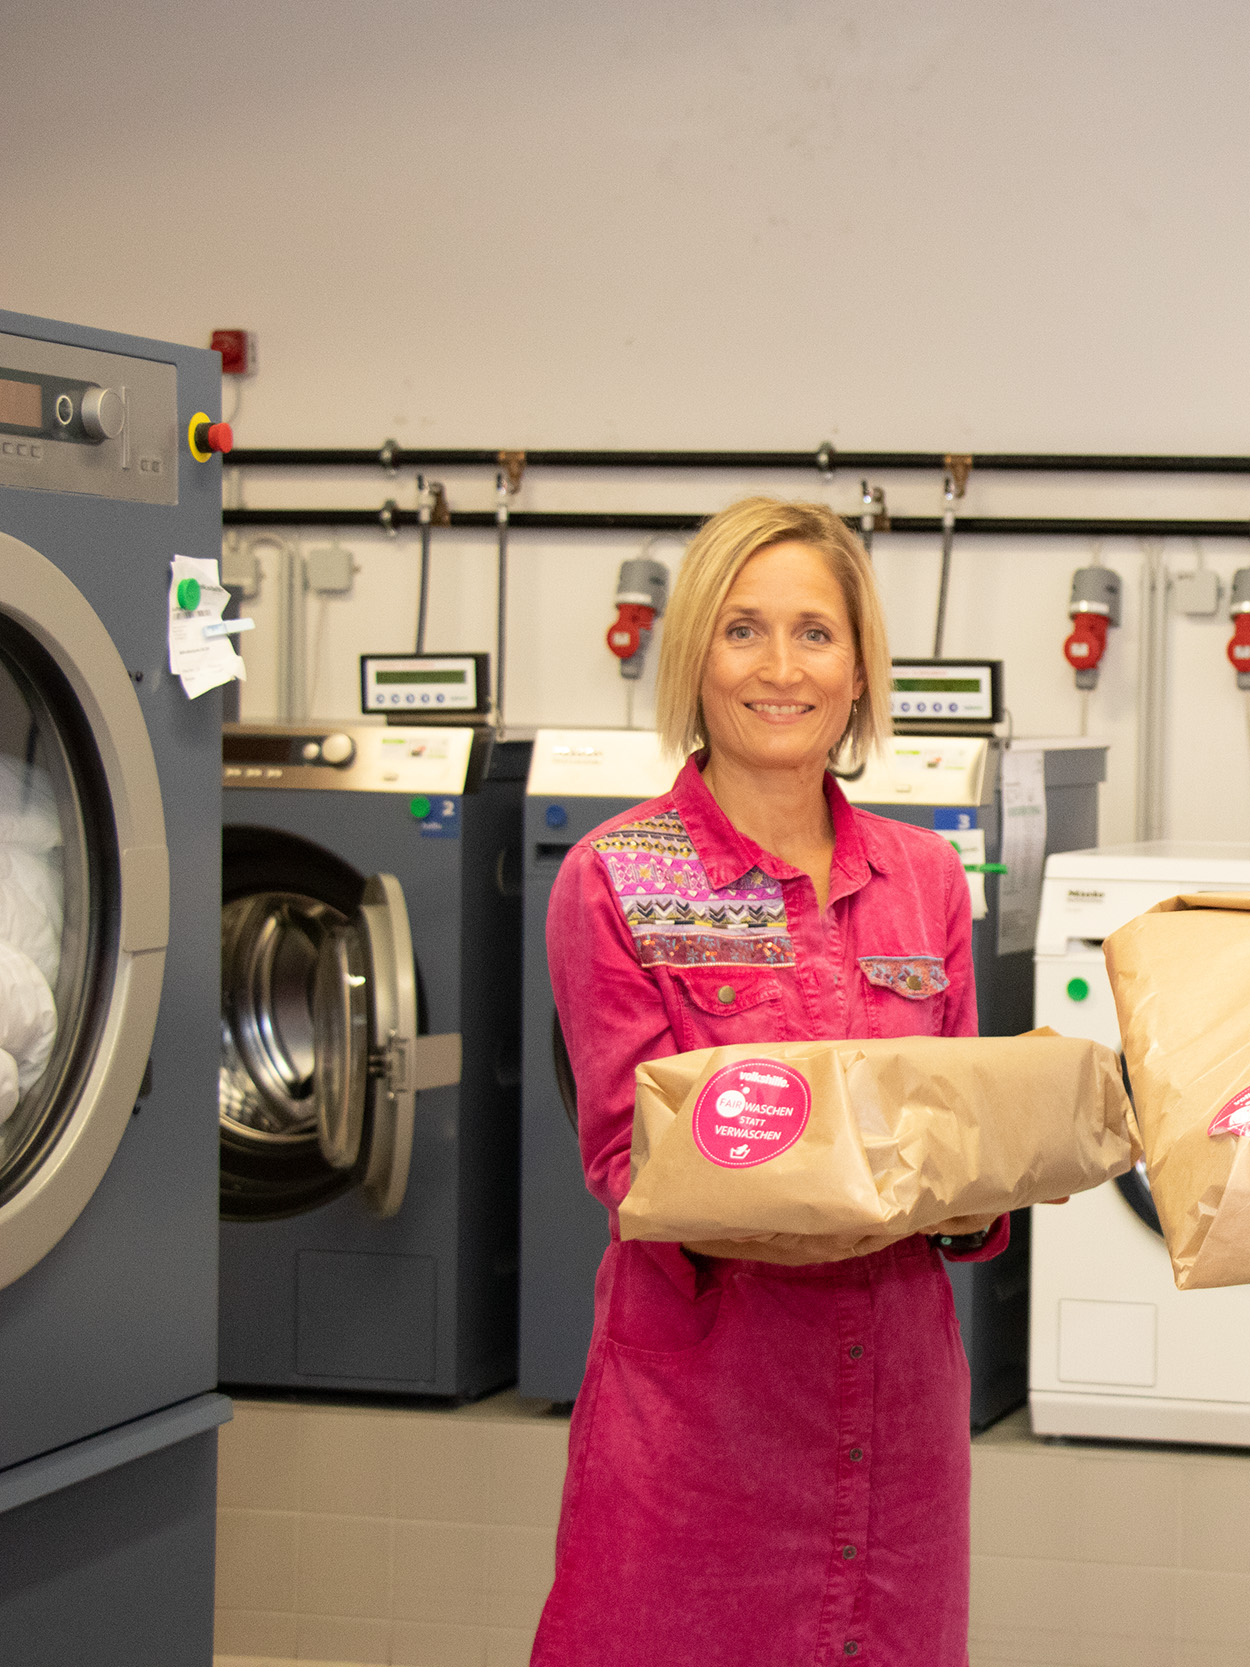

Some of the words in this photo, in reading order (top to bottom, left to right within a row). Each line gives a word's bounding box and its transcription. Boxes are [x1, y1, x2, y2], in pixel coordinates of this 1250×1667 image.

[442, 800, 455, 816] 2
[744, 1101, 794, 1117] WASCHEN
[739, 1116, 766, 1126] STATT
[715, 1124, 782, 1141] VERWASCHEN
